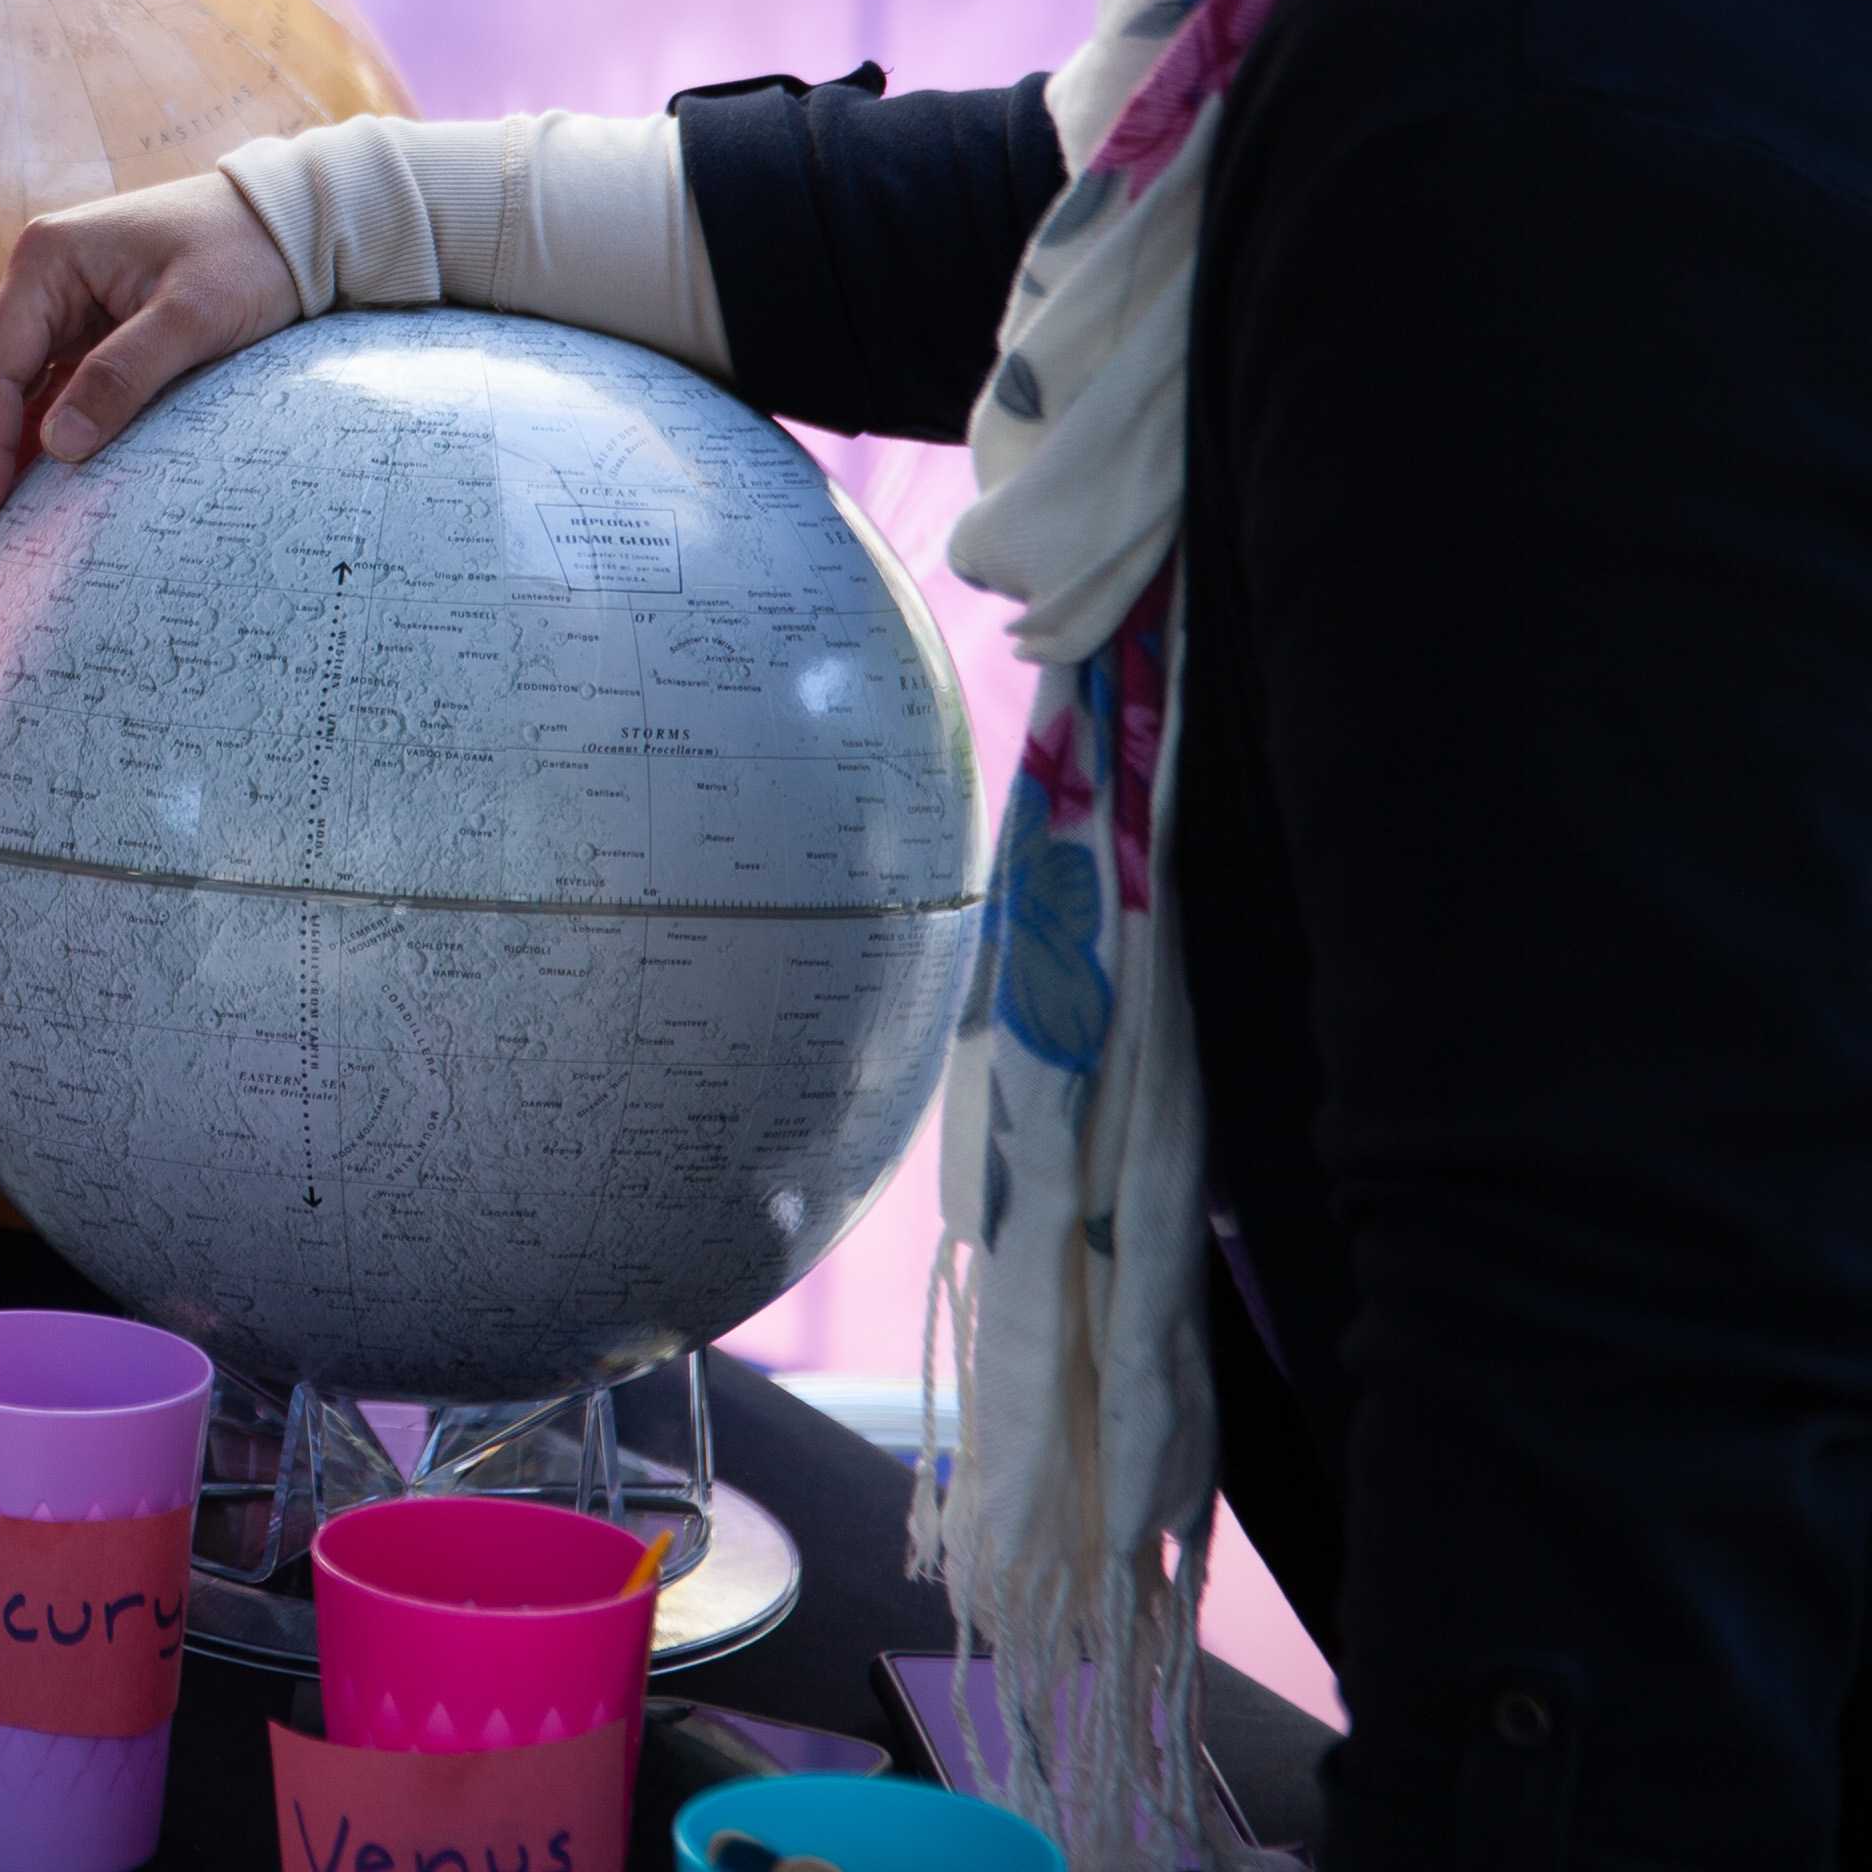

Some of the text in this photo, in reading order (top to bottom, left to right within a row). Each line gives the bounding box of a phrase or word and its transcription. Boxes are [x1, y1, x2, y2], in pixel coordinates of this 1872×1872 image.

[580, 487, 638, 497] OCEAN
[555, 535, 671, 546] LUNAR GLOBE
[468, 573, 497, 582] Beigh
[406, 580, 434, 588] Aston
[511, 593, 572, 603] Lichtenberg
[450, 611, 498, 620] RUSSELL
[635, 613, 657, 624] OF
[567, 633, 599, 641] Briggs
[459, 651, 499, 661] STRUVE
[517, 683, 578, 693] EDDINGTON
[349, 705, 398, 716] EINSTEIN
[434, 700, 469, 711] Balboa
[540, 724, 567, 732] Krafft
[621, 728, 690, 739] STORMS
[583, 744, 719, 756] (Oceanus Procellarum)
[406, 750, 441, 759] VASCO
[464, 753, 494, 762] GAMA
[542, 761, 589, 770] Cardanus
[315, 818, 326, 858] MOON
[594, 849, 645, 858] Cavalerius
[556, 879, 605, 887] HEVELIUS
[344, 923, 405, 957] MOUNTAINS
[504, 945, 551, 955] RICCIOLI
[433, 970, 481, 979] HARTWIG
[381, 984, 438, 1076] CORDILLERA
[239, 1072, 347, 1089] EASTERN SEA
[243, 1086, 275, 1096] (Mare
[385, 1111, 440, 1182] MOUNTAINS
[294, 1798, 572, 1872] Venus
